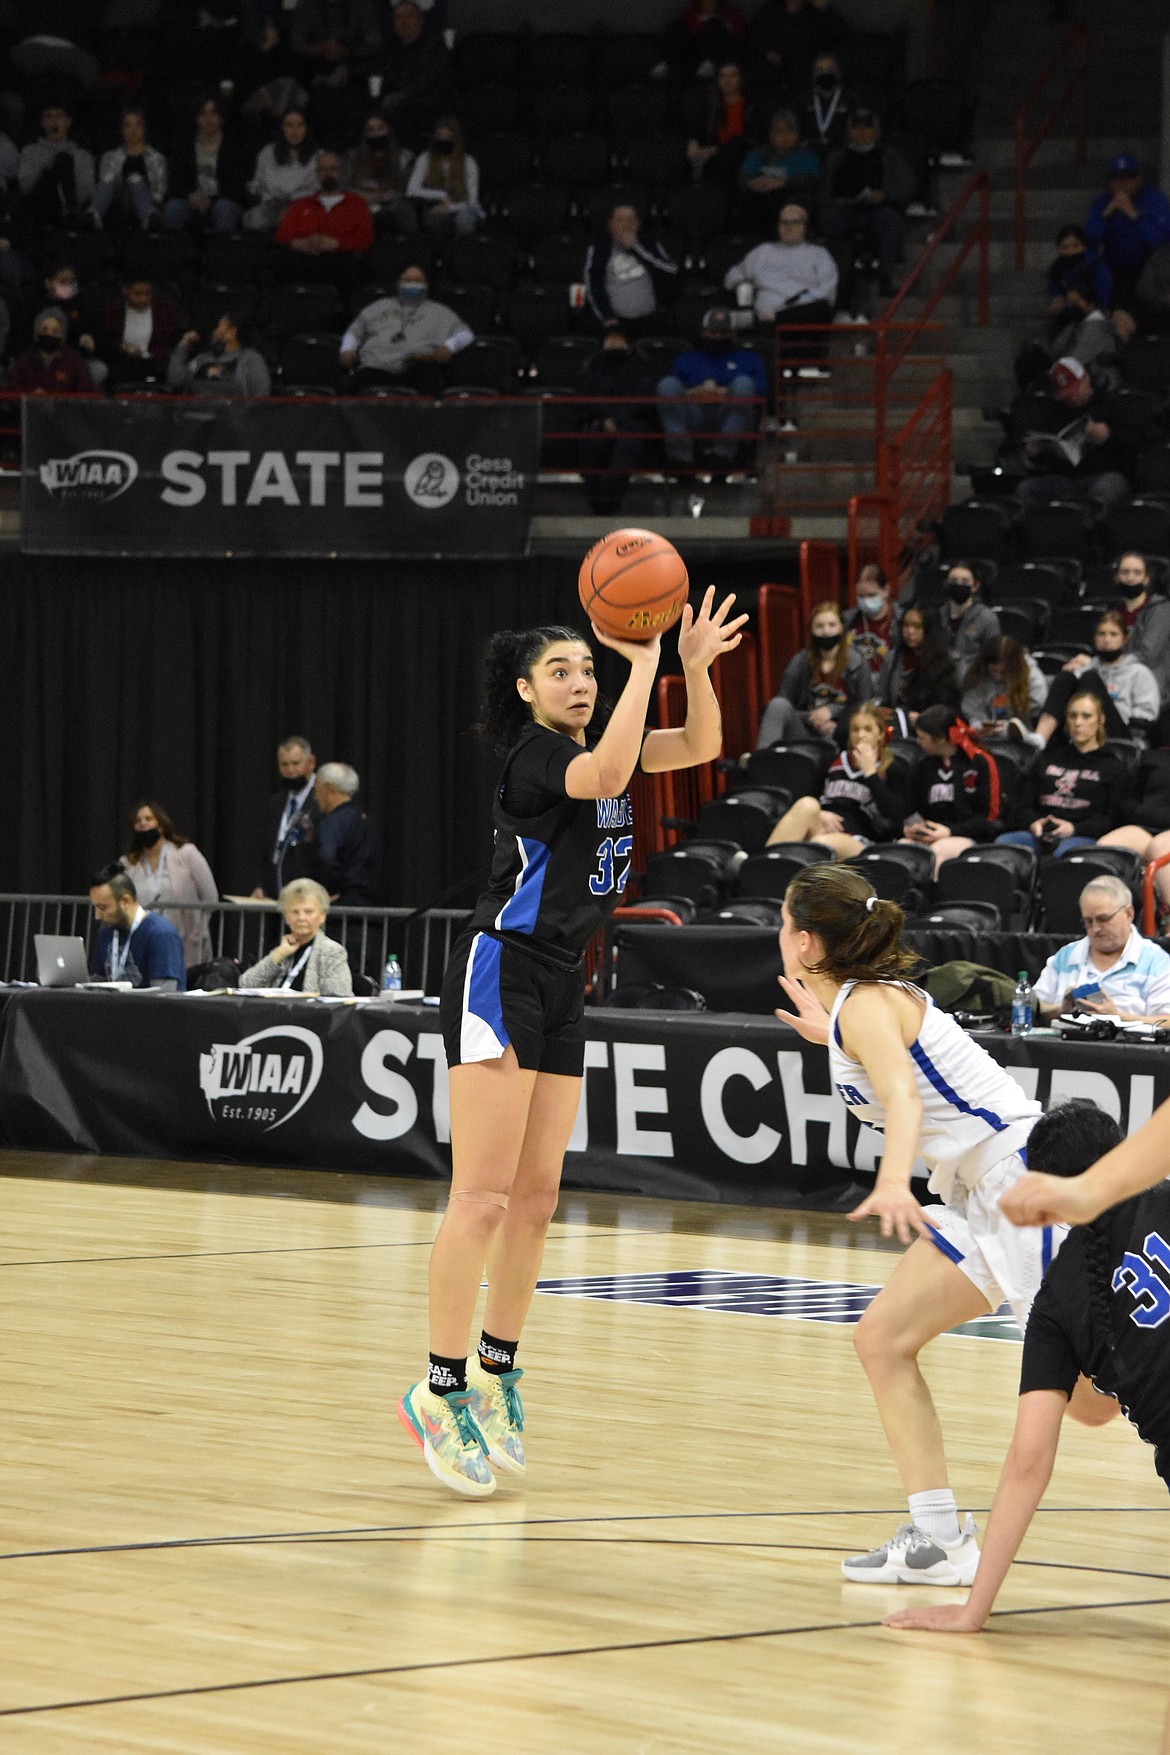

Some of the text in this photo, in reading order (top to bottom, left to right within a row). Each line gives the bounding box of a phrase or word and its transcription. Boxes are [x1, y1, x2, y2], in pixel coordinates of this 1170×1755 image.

[465, 454, 513, 472] Gesa
[55, 462, 122, 485] WIAA
[160, 450, 384, 506] STATE
[465, 471, 524, 489] Credit
[466, 489, 518, 507] Union
[218, 1049, 306, 1094] WIAA
[222, 1104, 278, 1122] Est. 1905
